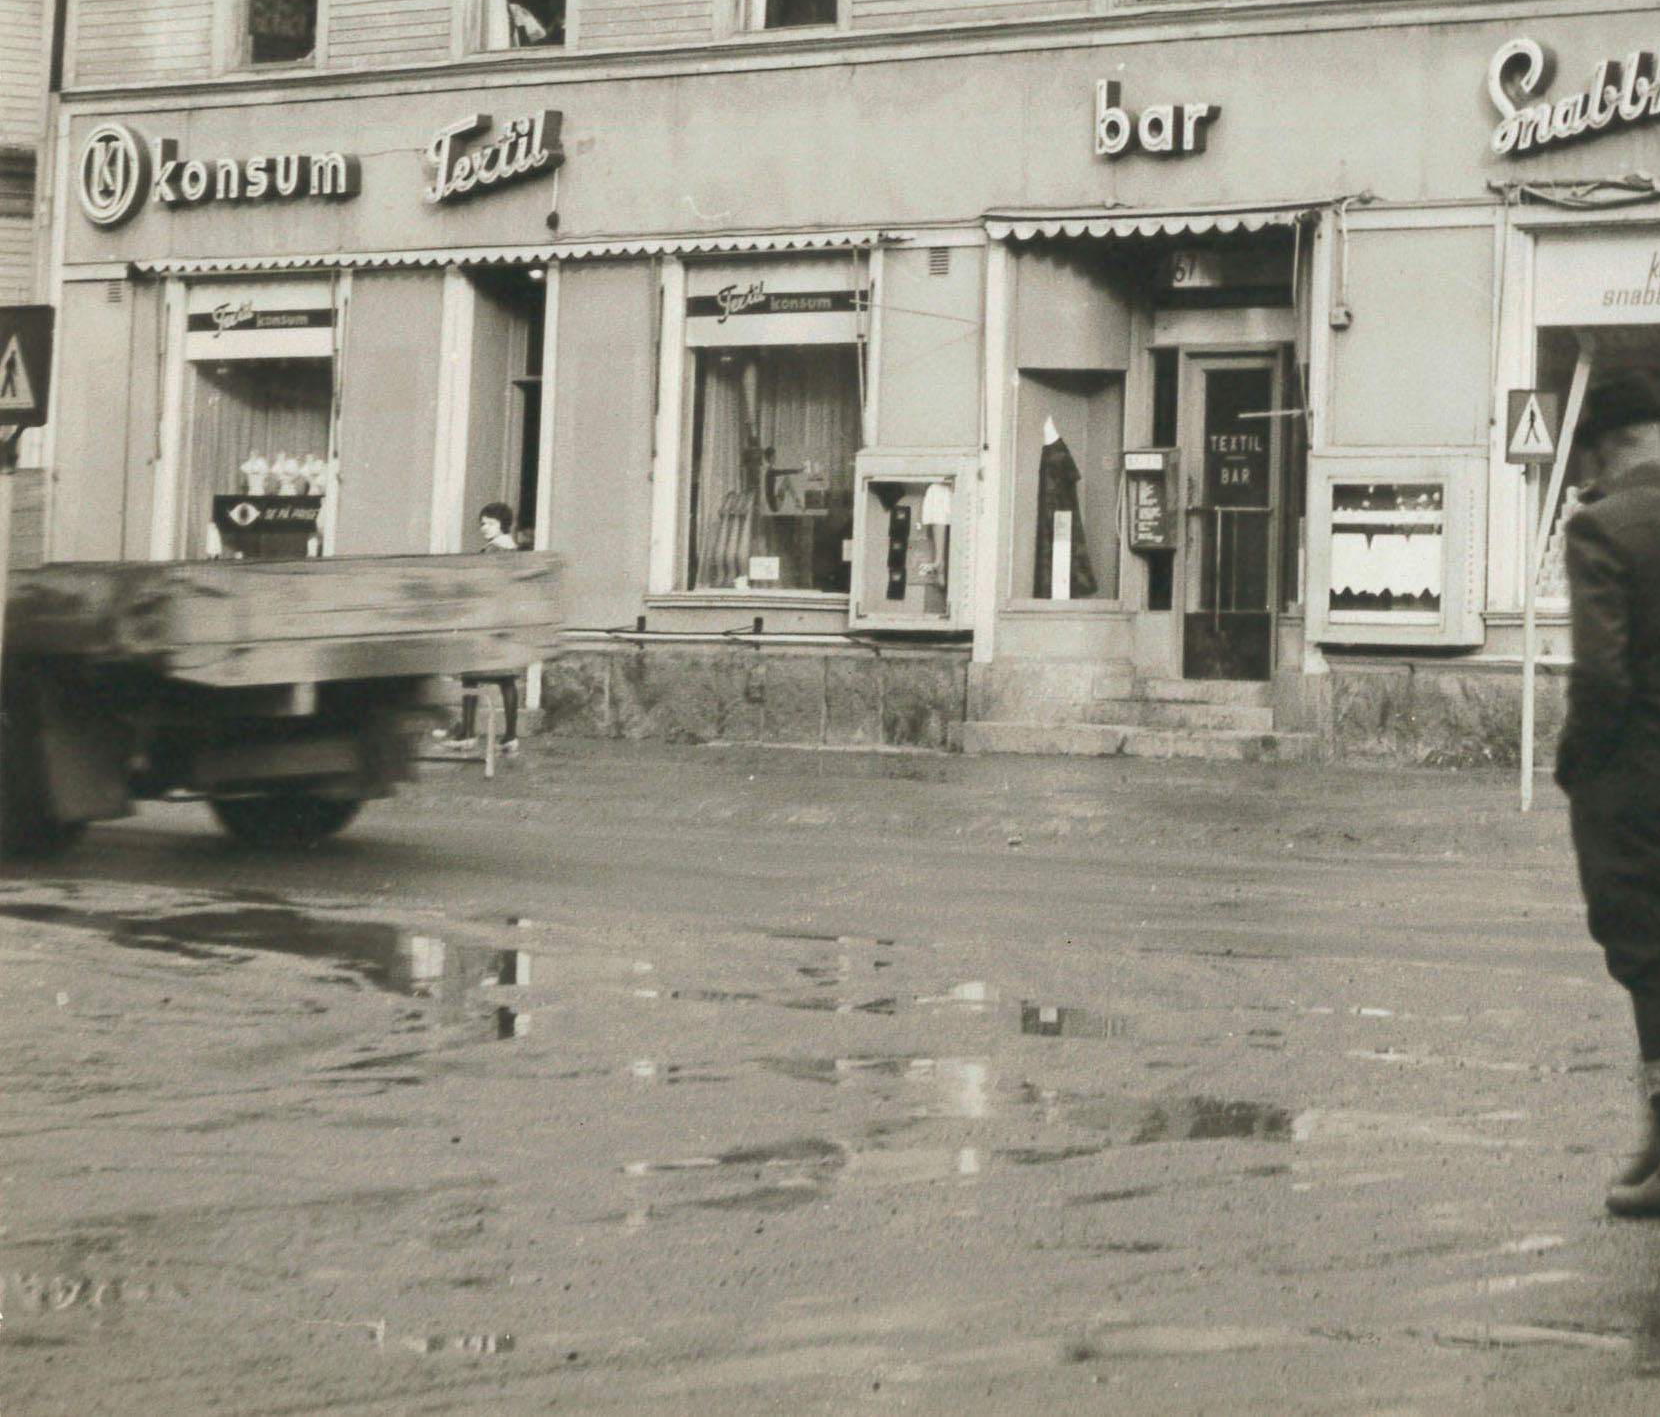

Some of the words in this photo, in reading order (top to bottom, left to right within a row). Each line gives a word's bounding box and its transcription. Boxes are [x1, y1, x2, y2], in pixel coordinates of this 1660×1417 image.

[1095, 78, 1213, 157] bar
[152, 137, 352, 204] konsum
[425, 109, 554, 204] Textil
[212, 301, 254, 339] Textil
[256, 313, 310, 328] konsum
[717, 281, 767, 324] Textil
[770, 295, 832, 312] konsum
[1210, 434, 1263, 452] TEXTIL
[1220, 467, 1250, 484] BAR
